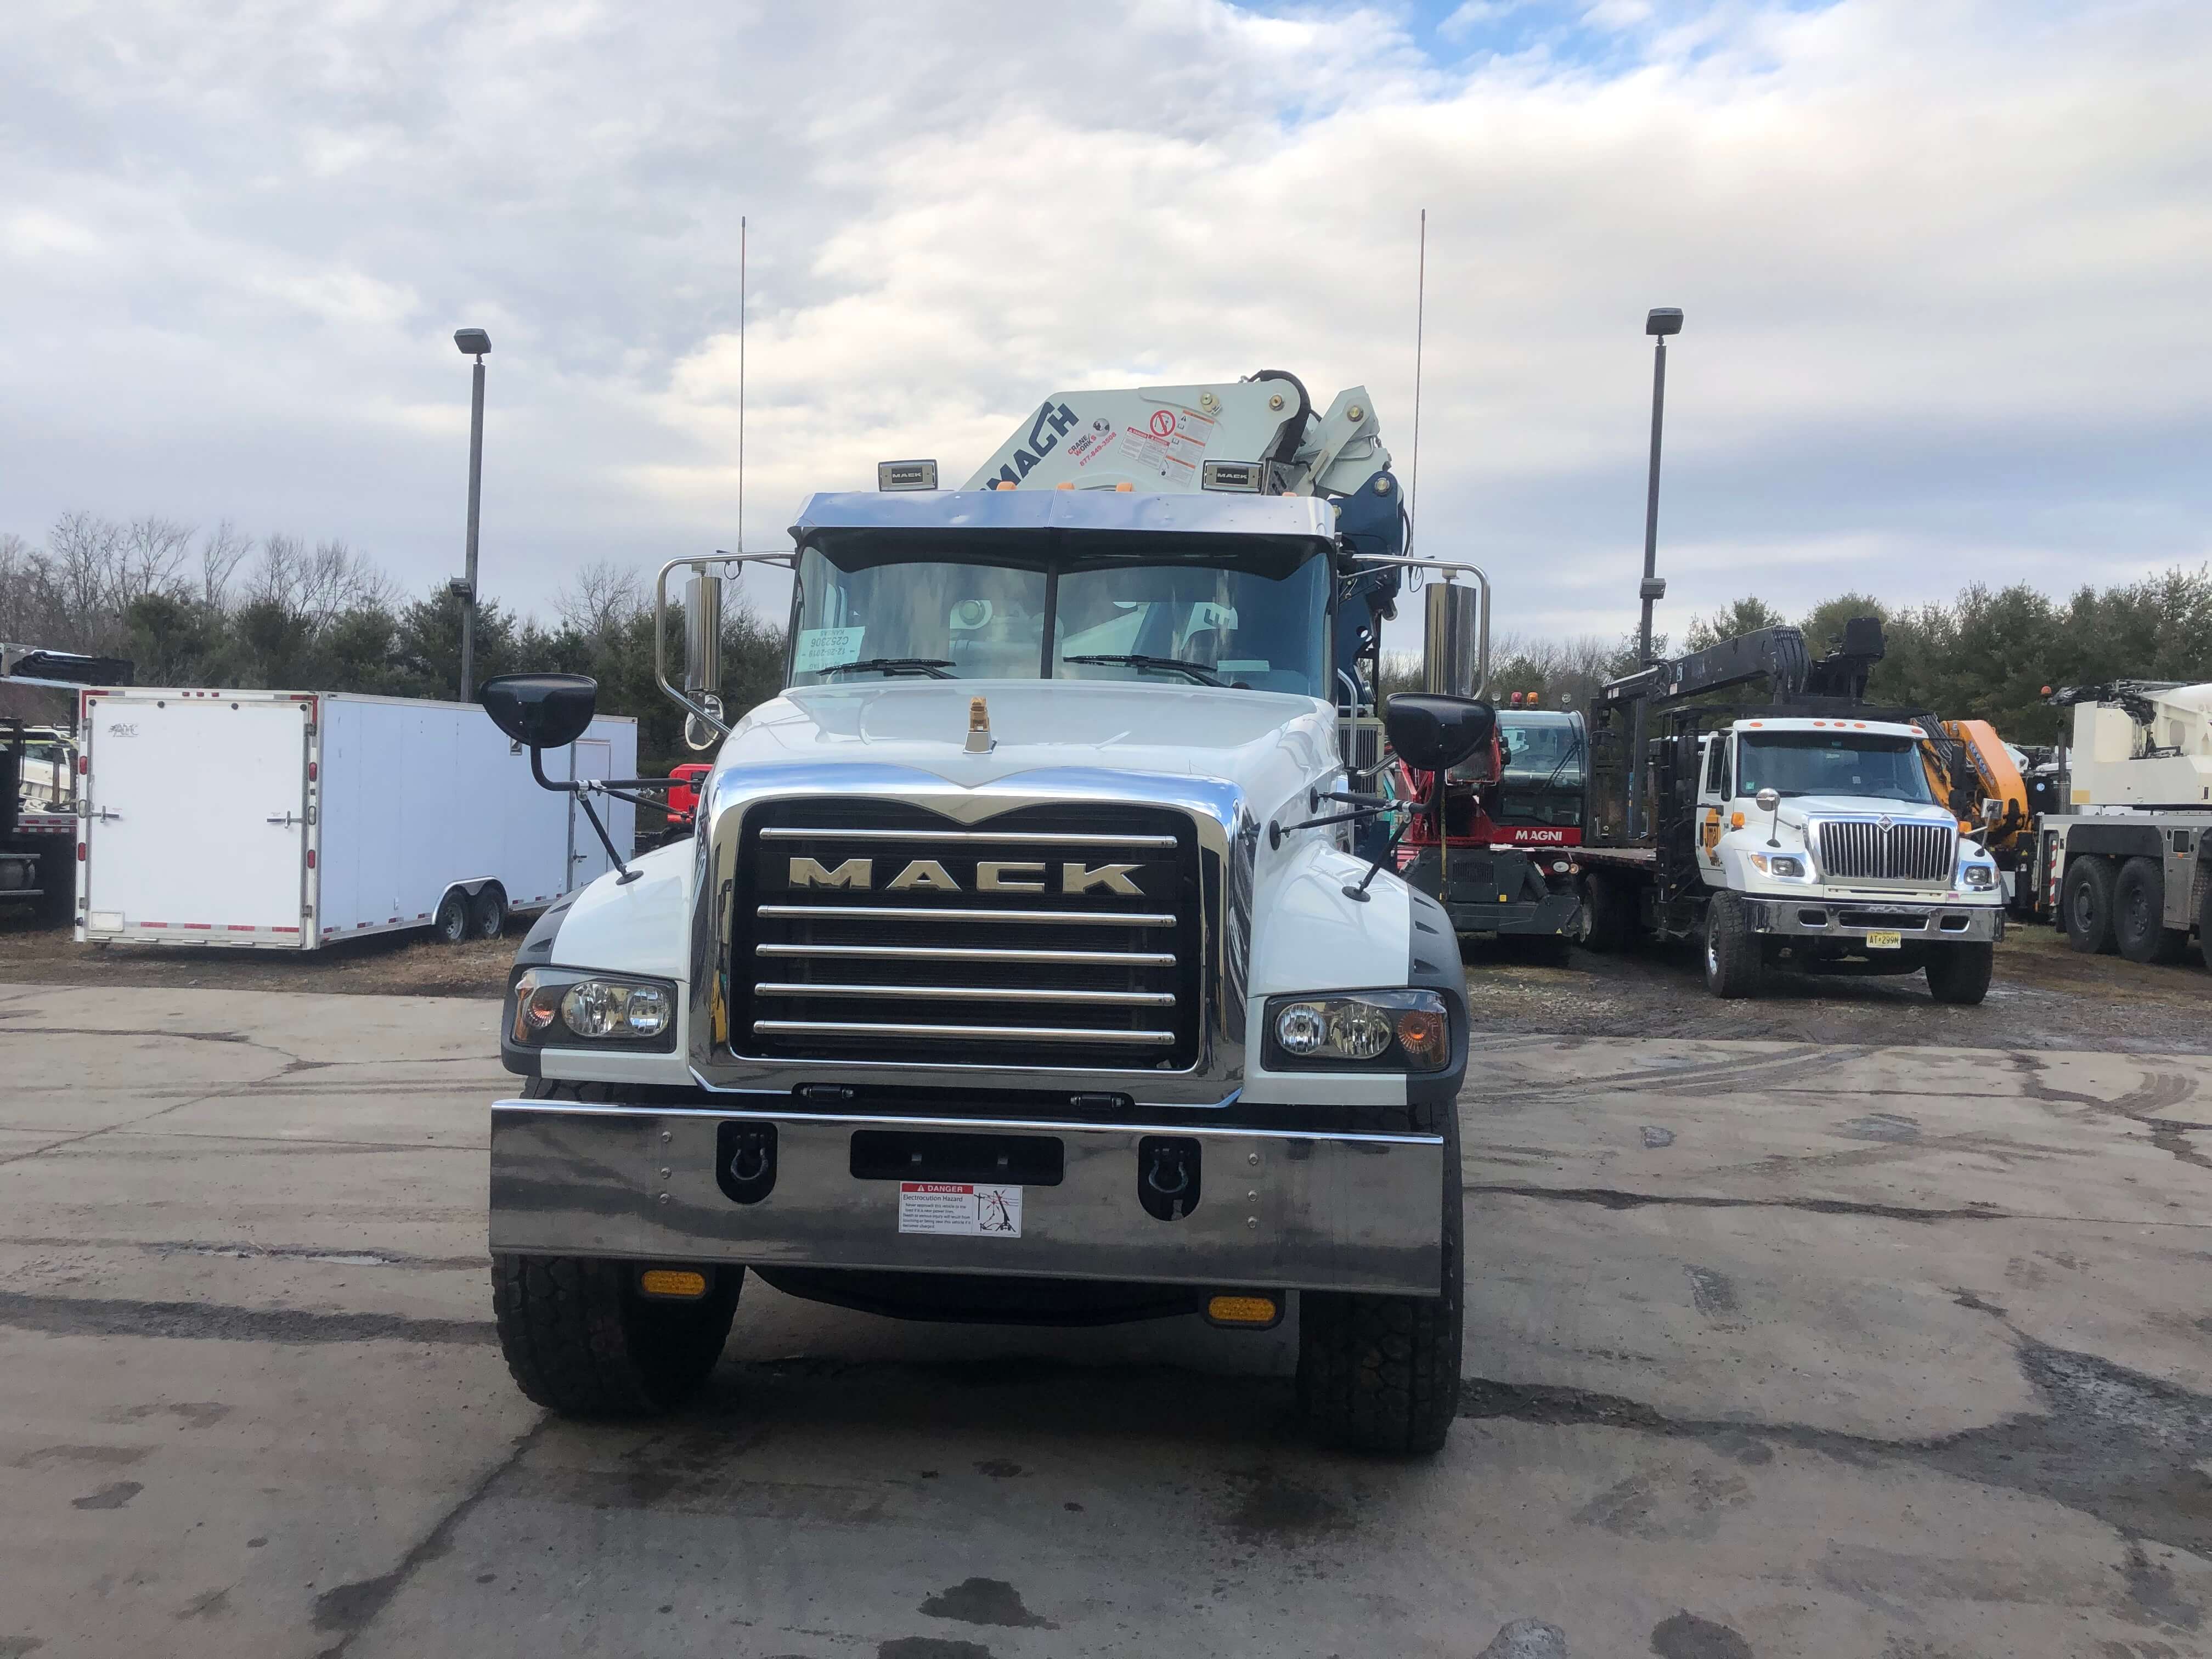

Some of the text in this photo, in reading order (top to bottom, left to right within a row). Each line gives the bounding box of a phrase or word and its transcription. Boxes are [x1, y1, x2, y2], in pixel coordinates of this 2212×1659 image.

[1068, 435, 1088, 455] CRANE
[1074, 433, 1097, 456] WORKS
[1515, 830, 1562, 841] MAGNI
[788, 857, 1146, 895] MACK
